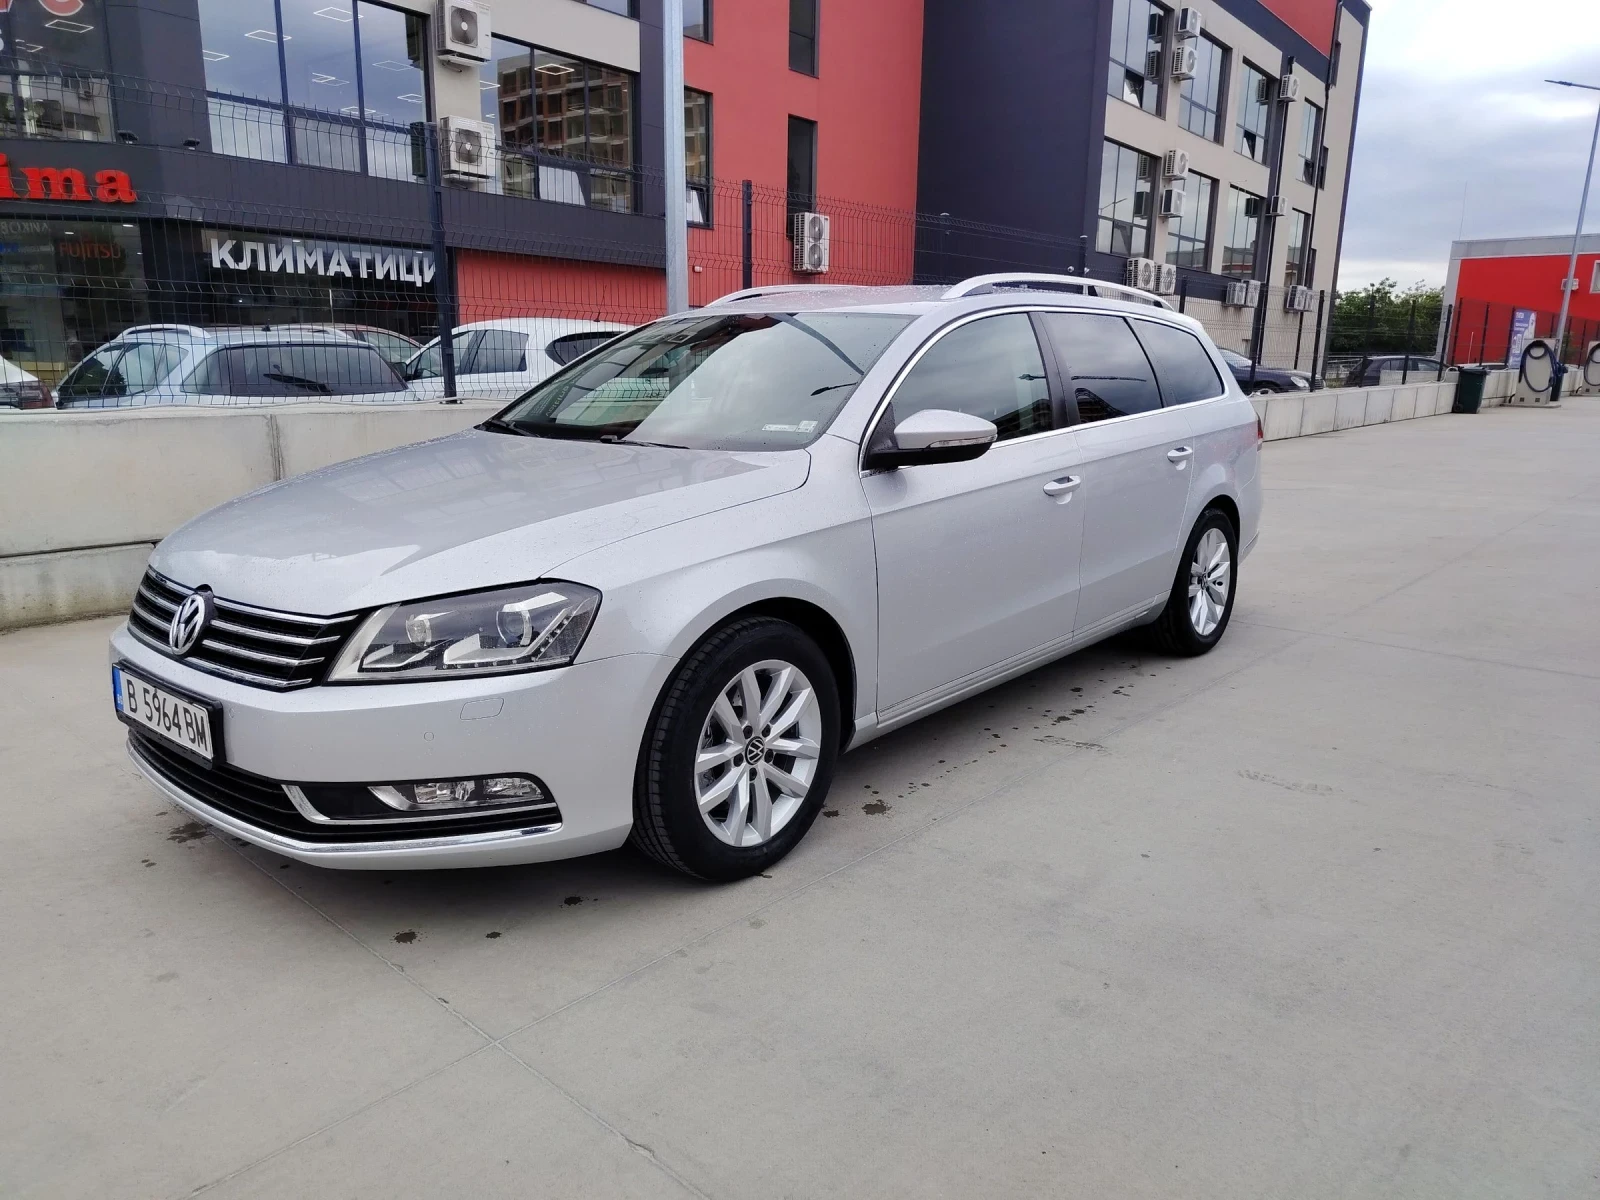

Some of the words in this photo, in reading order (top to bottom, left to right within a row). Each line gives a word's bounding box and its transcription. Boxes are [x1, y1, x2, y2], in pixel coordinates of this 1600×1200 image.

[126, 679, 138, 714] B
[142, 687, 182, 738] 5964
[182, 706, 208, 752] BM
